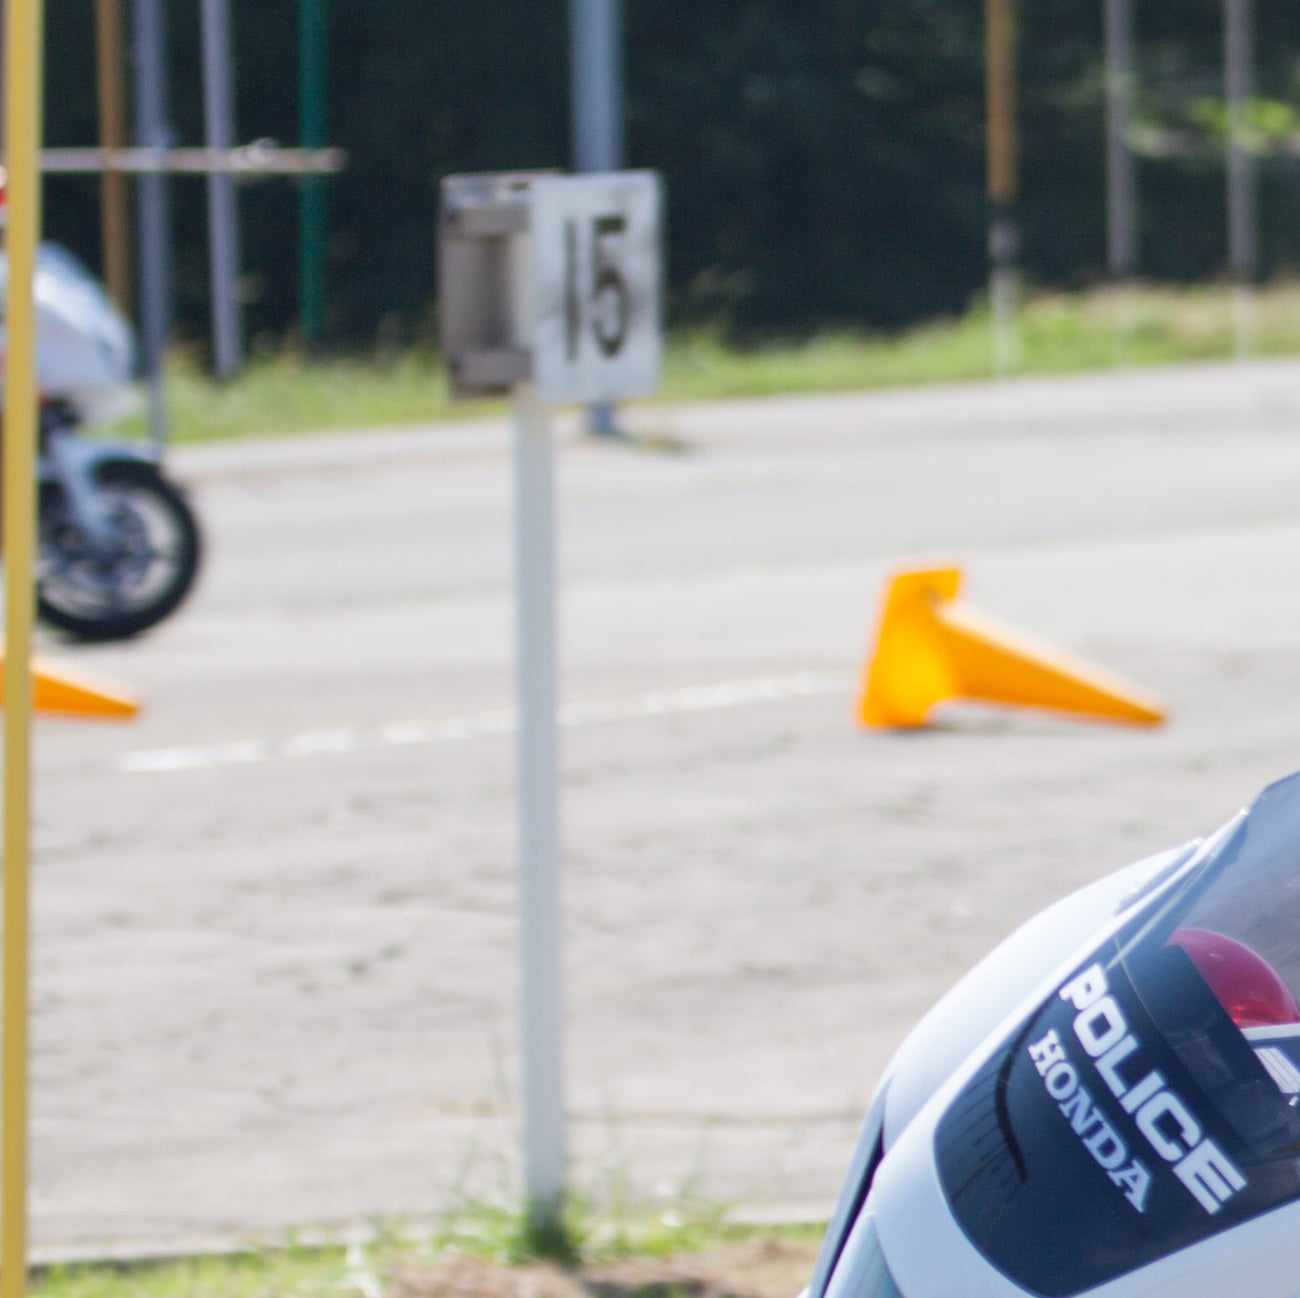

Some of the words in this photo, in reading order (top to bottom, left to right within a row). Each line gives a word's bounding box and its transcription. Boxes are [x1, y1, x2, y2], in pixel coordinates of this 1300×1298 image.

[563, 214, 629, 363] 15
[1028, 1029, 1154, 1213] HONDA
[1059, 962, 1247, 1215] POLICE
